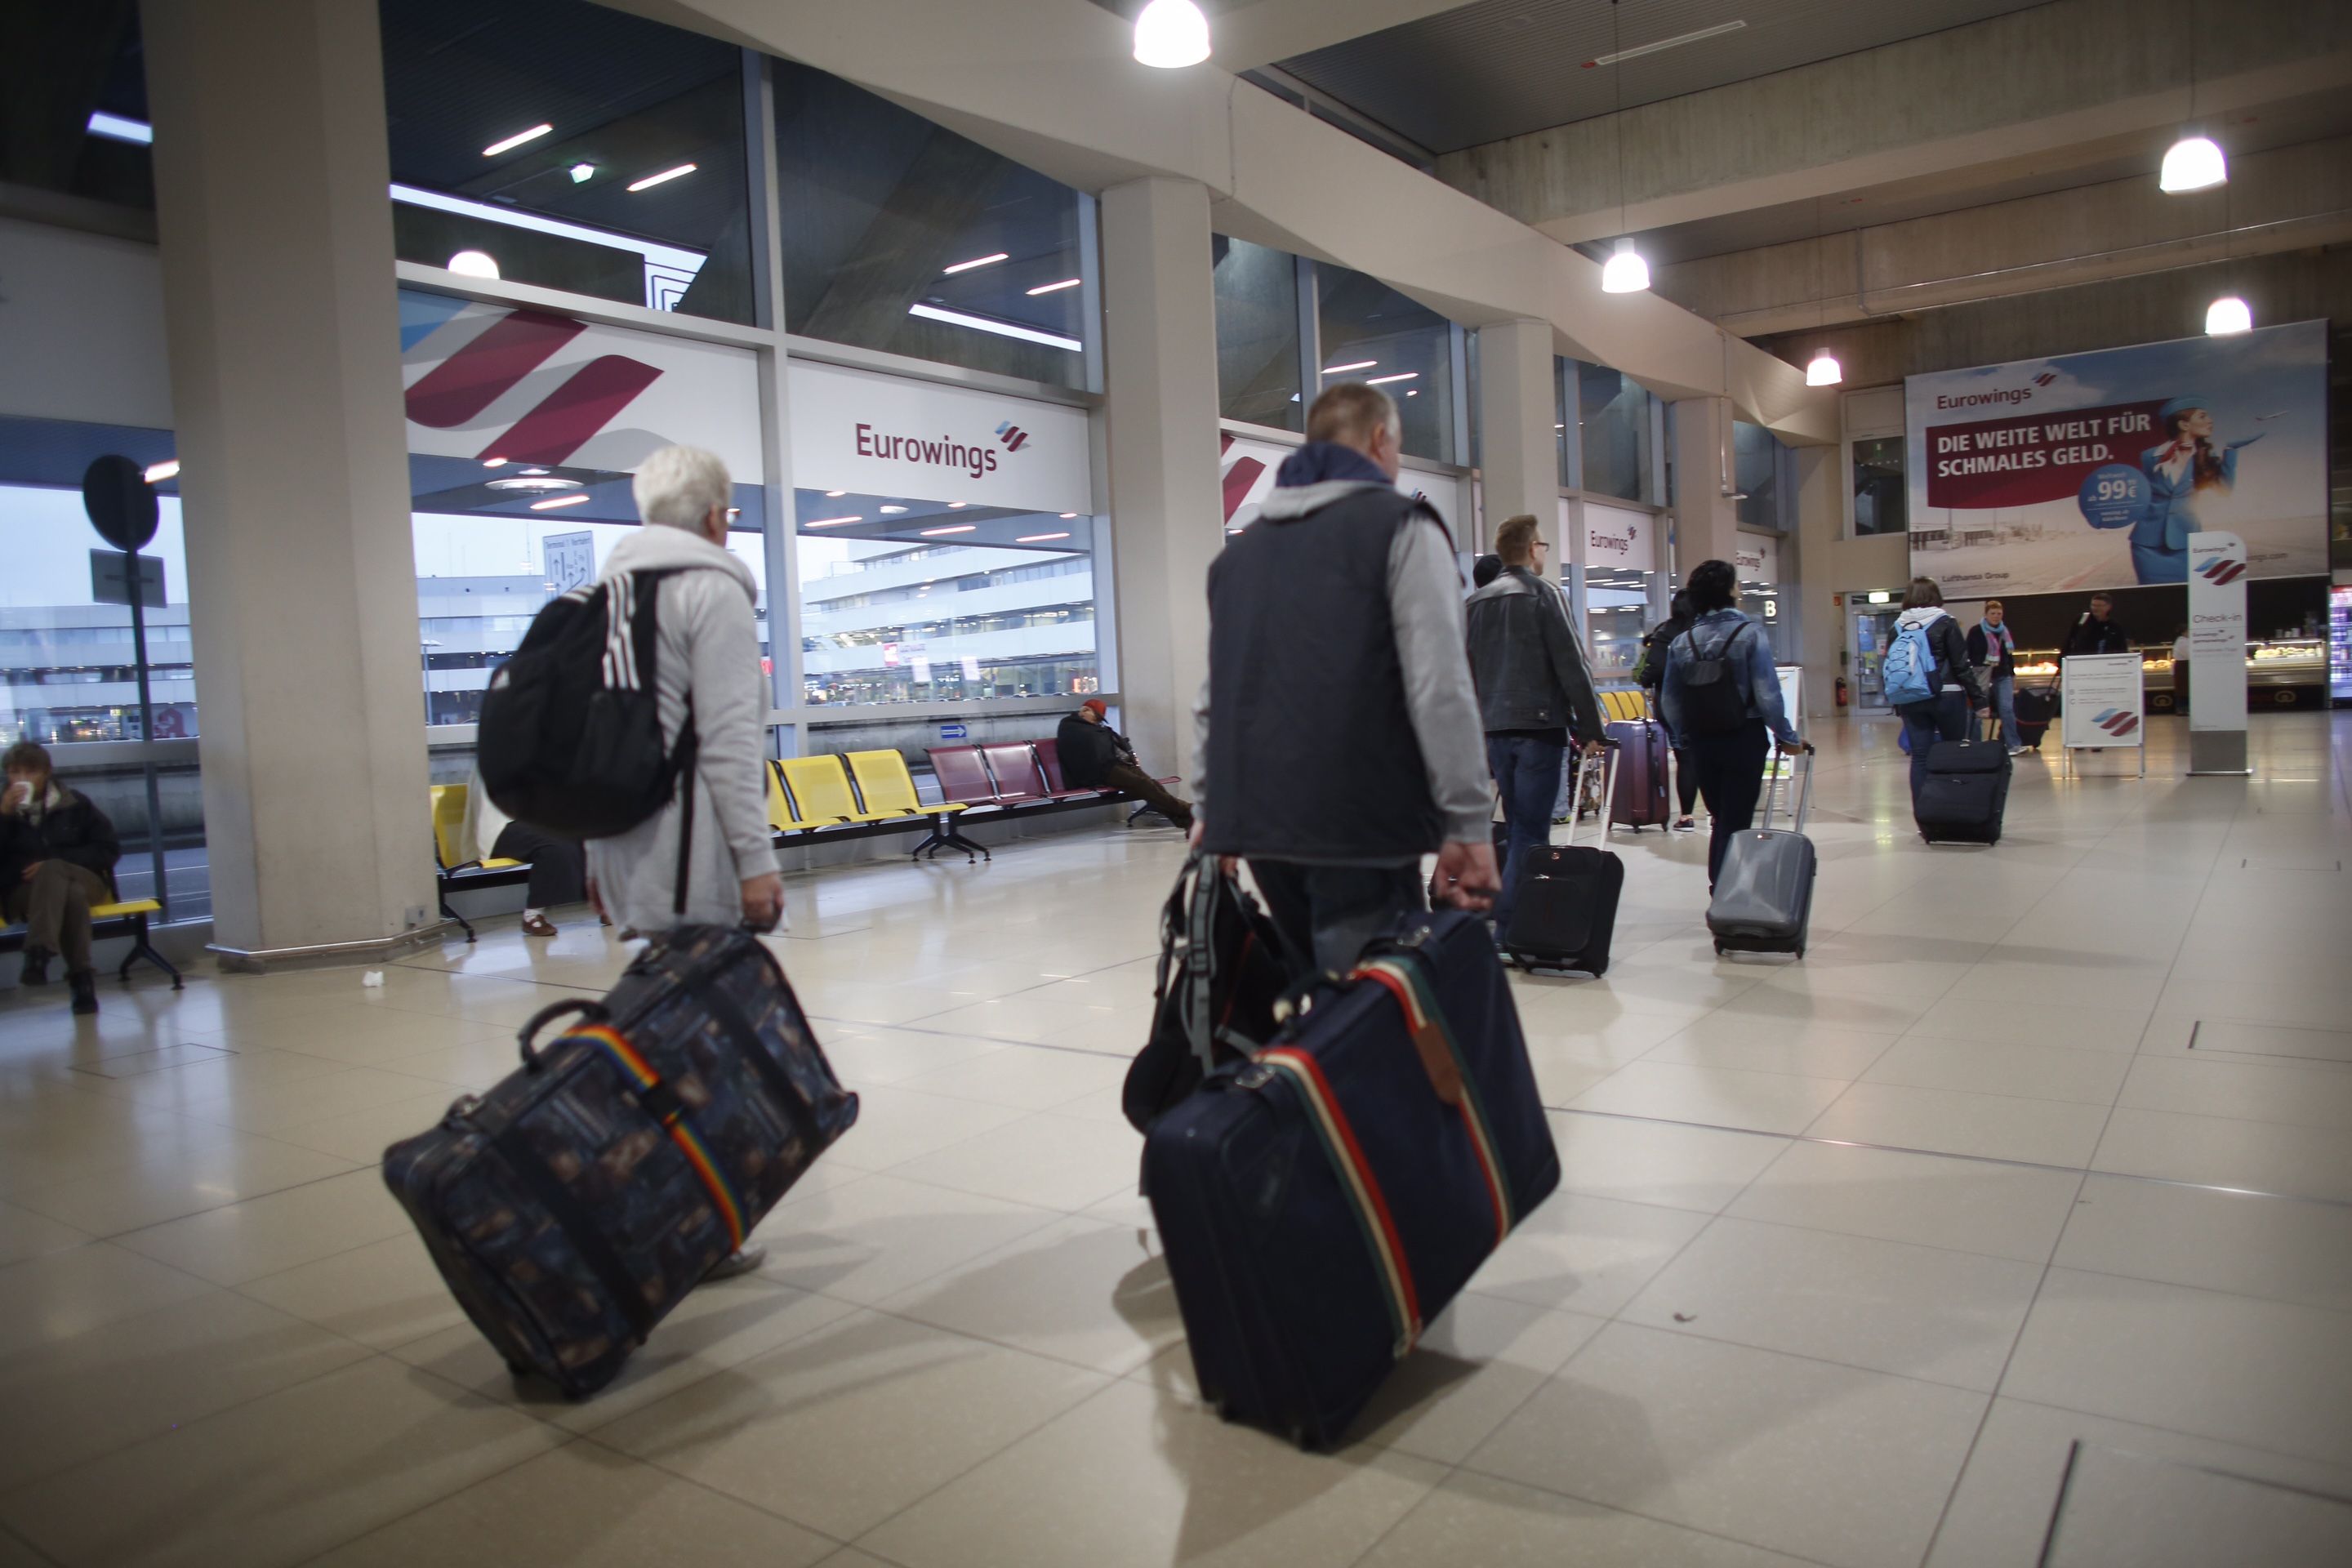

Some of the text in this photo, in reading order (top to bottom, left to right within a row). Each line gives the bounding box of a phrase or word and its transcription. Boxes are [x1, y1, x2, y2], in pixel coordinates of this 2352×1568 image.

[1937, 388, 2033, 410] Eurowings
[1938, 411, 2151, 453] DIE WEITE WELT FÜR
[854, 422, 998, 479] Eurowings
[1938, 443, 2114, 478] SCHMALES GELD.
[1590, 530, 1628, 555] Eurowings
[1941, 572, 2010, 582] Lufthansa Group
[1764, 600, 1777, 617] B
[2193, 613, 2243, 624] Check-in
